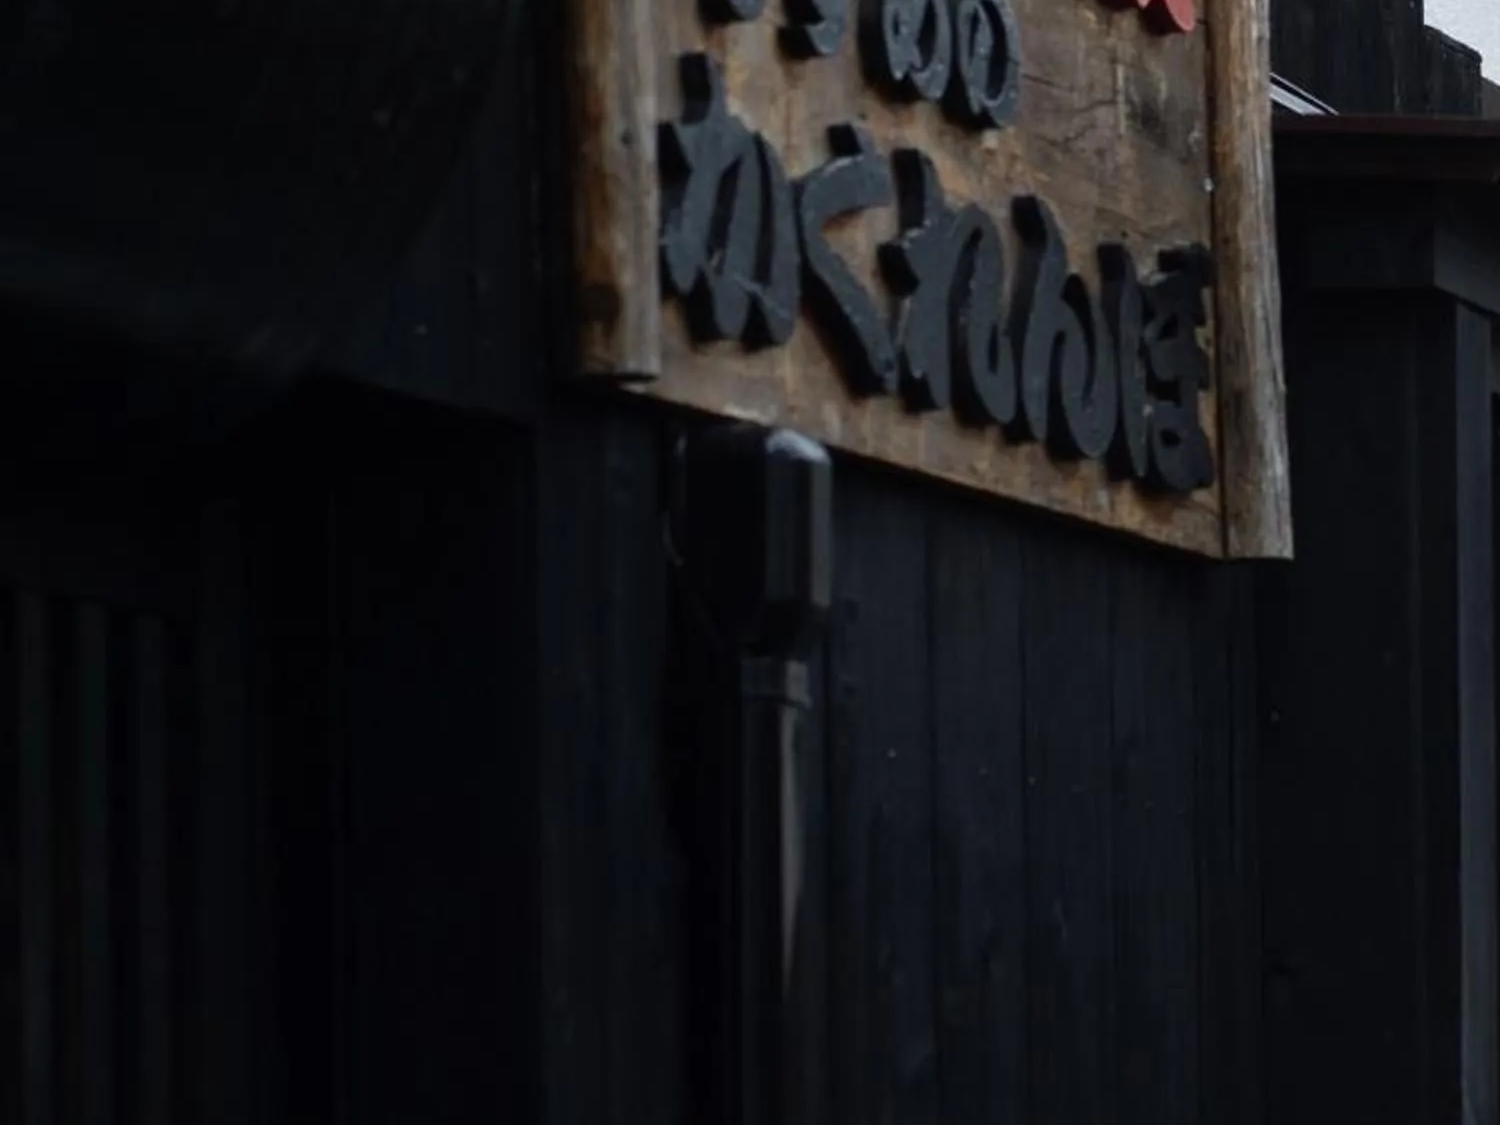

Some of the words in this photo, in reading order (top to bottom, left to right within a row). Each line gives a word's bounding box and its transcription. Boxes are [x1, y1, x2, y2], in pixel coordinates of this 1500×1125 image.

[658, 51, 1214, 492] かくれんぼ
